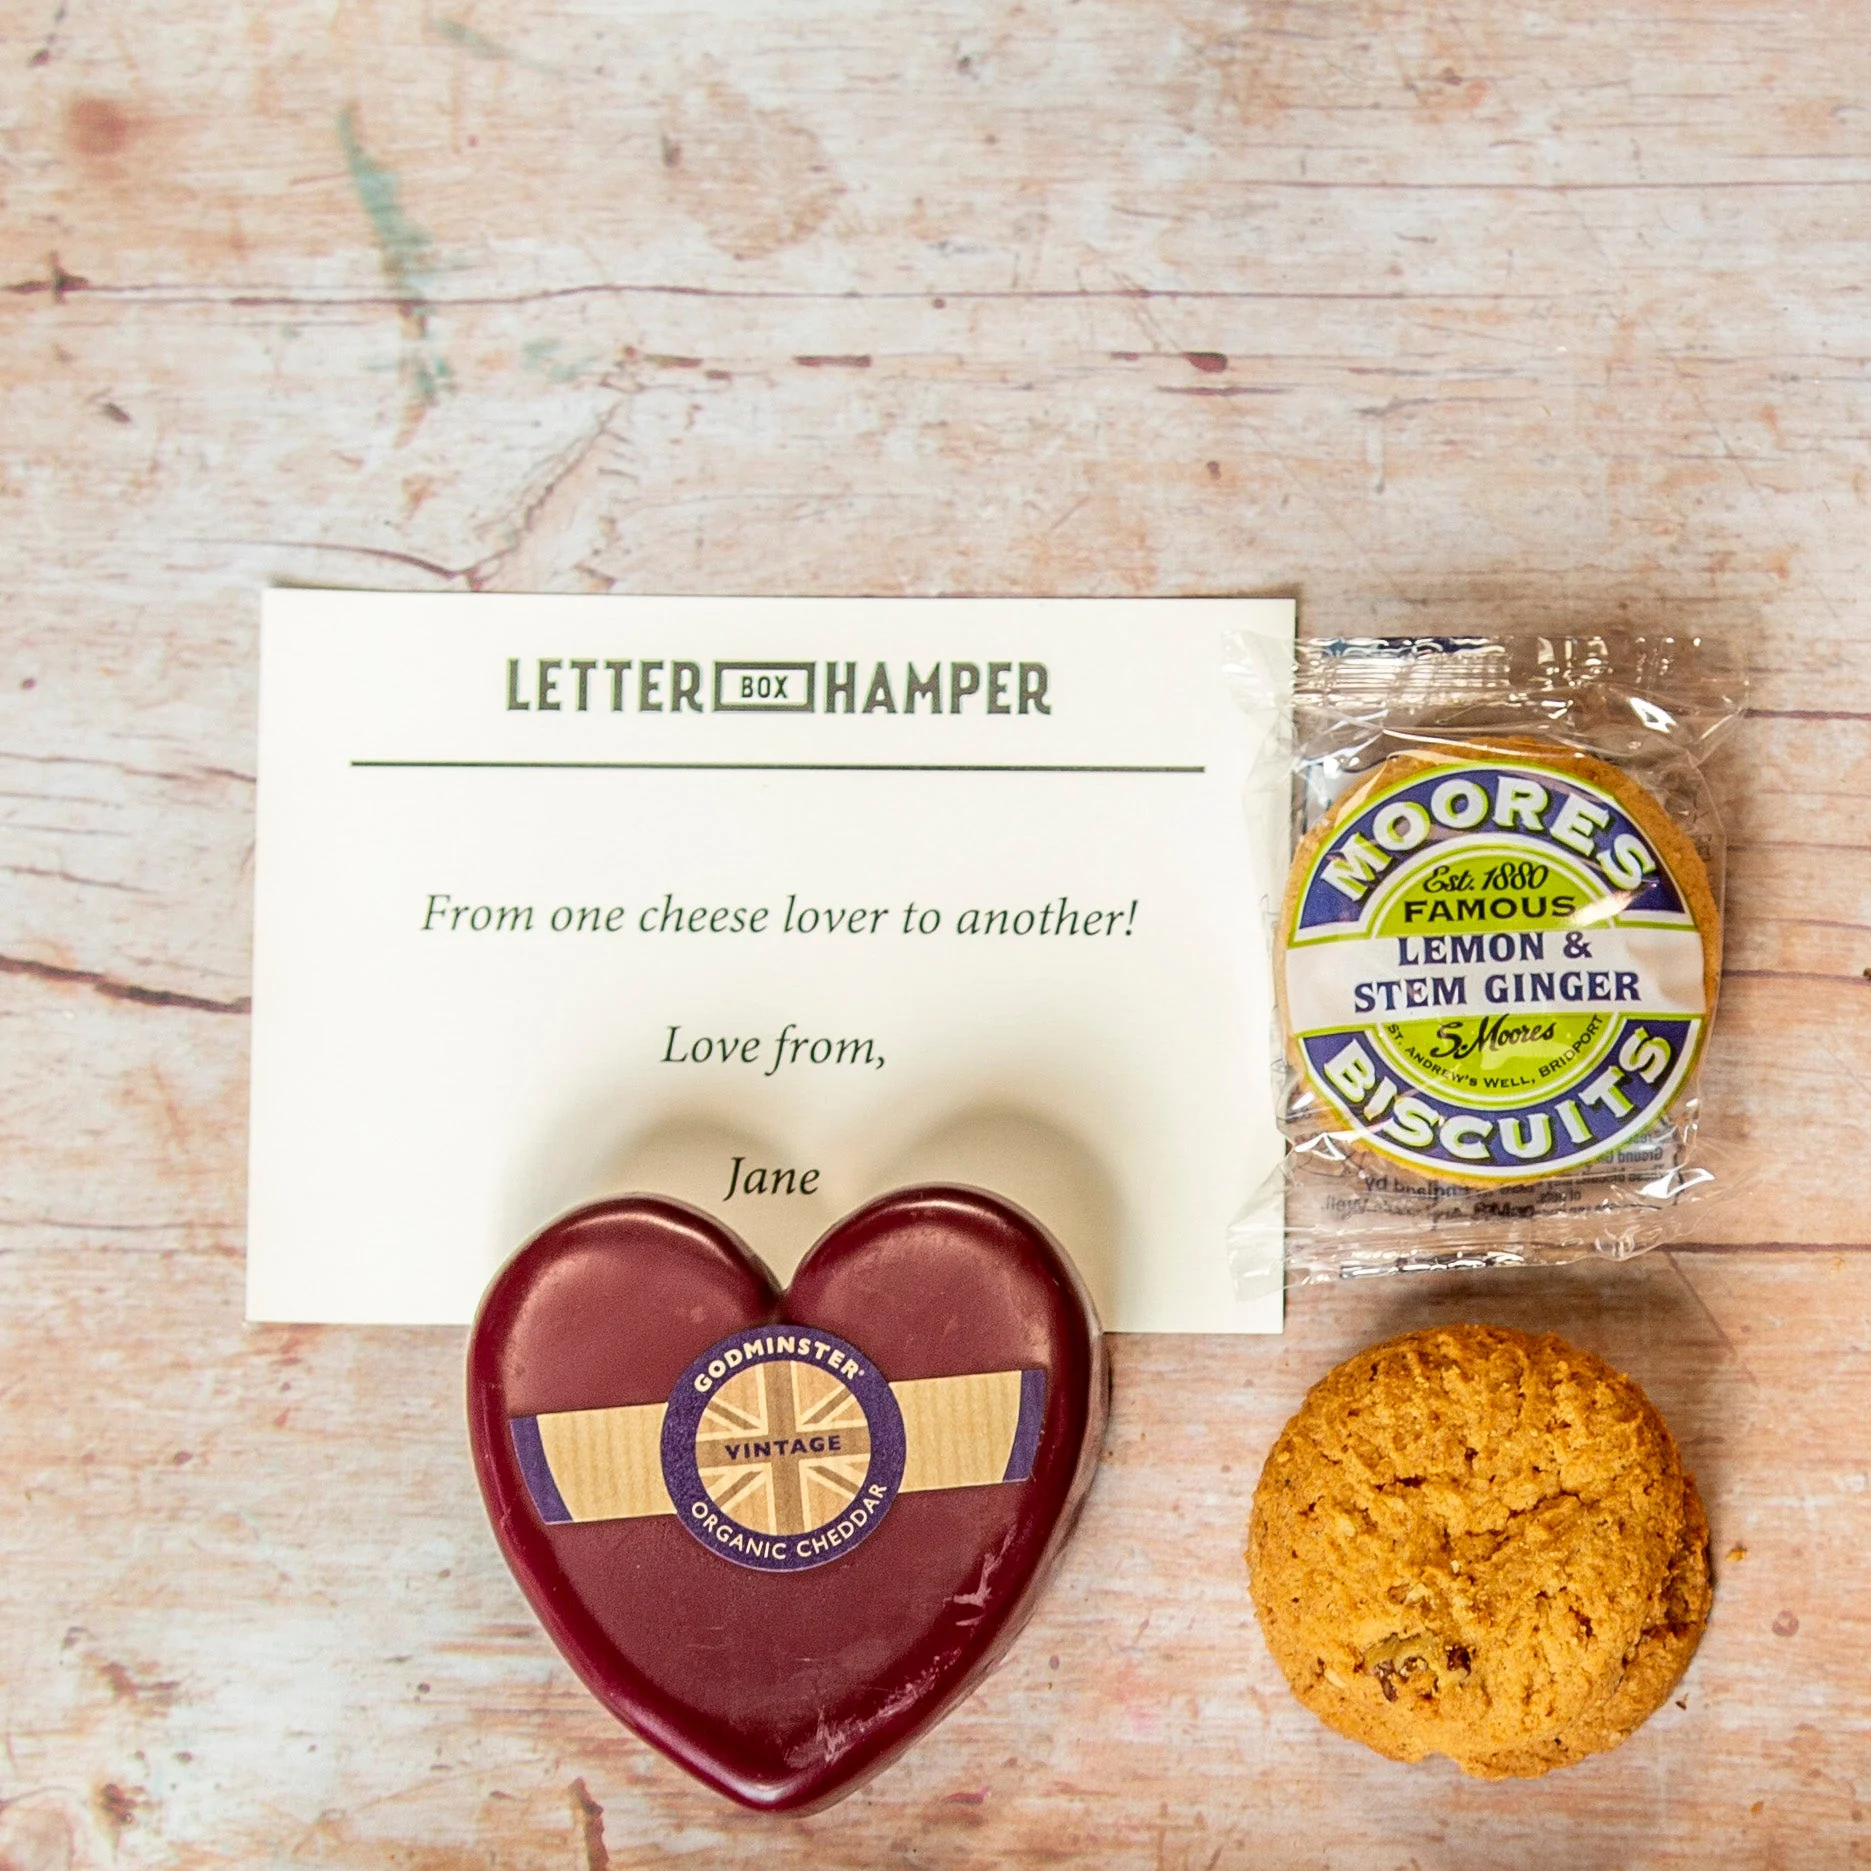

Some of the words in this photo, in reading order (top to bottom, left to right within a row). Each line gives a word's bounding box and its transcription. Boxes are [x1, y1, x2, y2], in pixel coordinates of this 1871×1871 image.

[506, 658, 704, 716] LETTER
[740, 675, 789, 700] BOX
[824, 661, 1052, 717] HAMPER
[1320, 776, 1657, 901] MOORES
[1424, 865, 1474, 893] Est.
[1482, 862, 1549, 891] 1880
[421, 894, 534, 934] From
[551, 901, 624, 934] one
[640, 895, 768, 935] cheese
[785, 895, 889, 936] lover
[904, 902, 942, 936] to
[956, 897, 1139, 938] another!
[1404, 895, 1576, 923] FAMOUS
[1398, 932, 1545, 967] LEMON
[1563, 931, 1593, 959] &
[1354, 978, 1468, 1013] STEM
[1484, 971, 1641, 1004] GINGER
[662, 1025, 762, 1067] Love
[764, 1024, 887, 1078] from,
[1387, 1023, 1404, 1046] ST.
[1484, 1076, 1536, 1089] WELL,
[1538, 1014, 1604, 1078] BRIDPORT
[1322, 1026, 1672, 1160] BISCUITS
[723, 1157, 819, 1201] Jane
[694, 1336, 861, 1393] GODMINSTER
[725, 1435, 841, 1460] VINTAGE
[691, 1501, 786, 1560] ORGANIC
[796, 1484, 887, 1558] CHEDDAR
